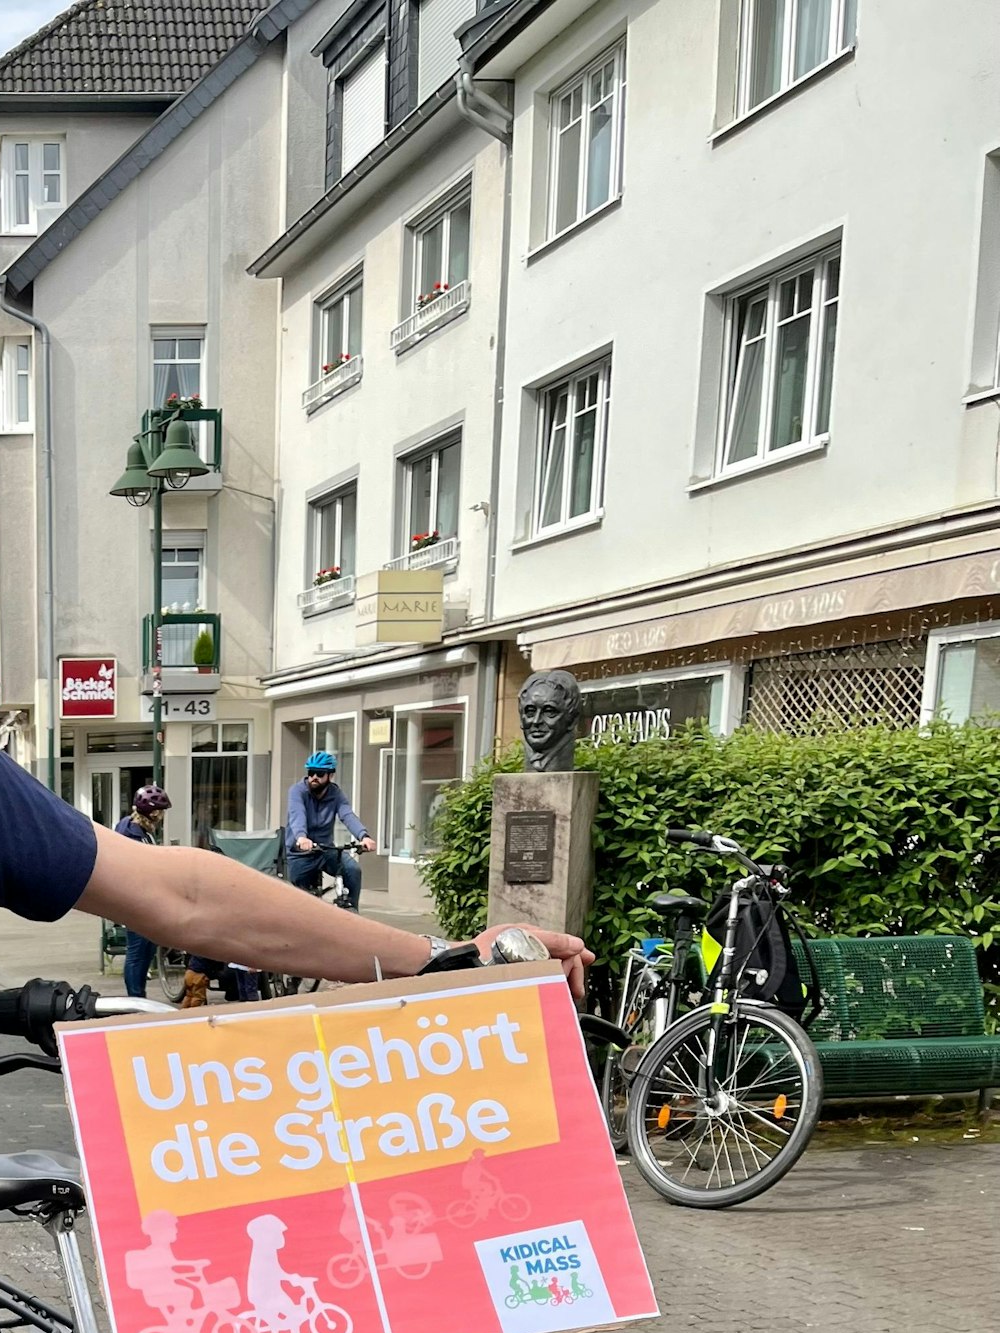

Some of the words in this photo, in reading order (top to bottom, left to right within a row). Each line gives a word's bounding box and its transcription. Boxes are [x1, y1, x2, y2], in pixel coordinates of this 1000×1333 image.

[382, 600, 438, 613] MARIE
[760, 599, 795, 628] QUO
[800, 589, 847, 618] VADIS
[62, 688, 115, 701] Schmidt
[65, 677, 112, 690] Bäcker
[625, 708, 671, 743] VADIS
[131, 1052, 273, 1111] Uns
[287, 1013, 528, 1111] gehört
[150, 1119, 261, 1184] die
[274, 1093, 511, 1170] Straße
[499, 1235, 577, 1264] KIDICAL
[525, 1253, 581, 1276] MASS
